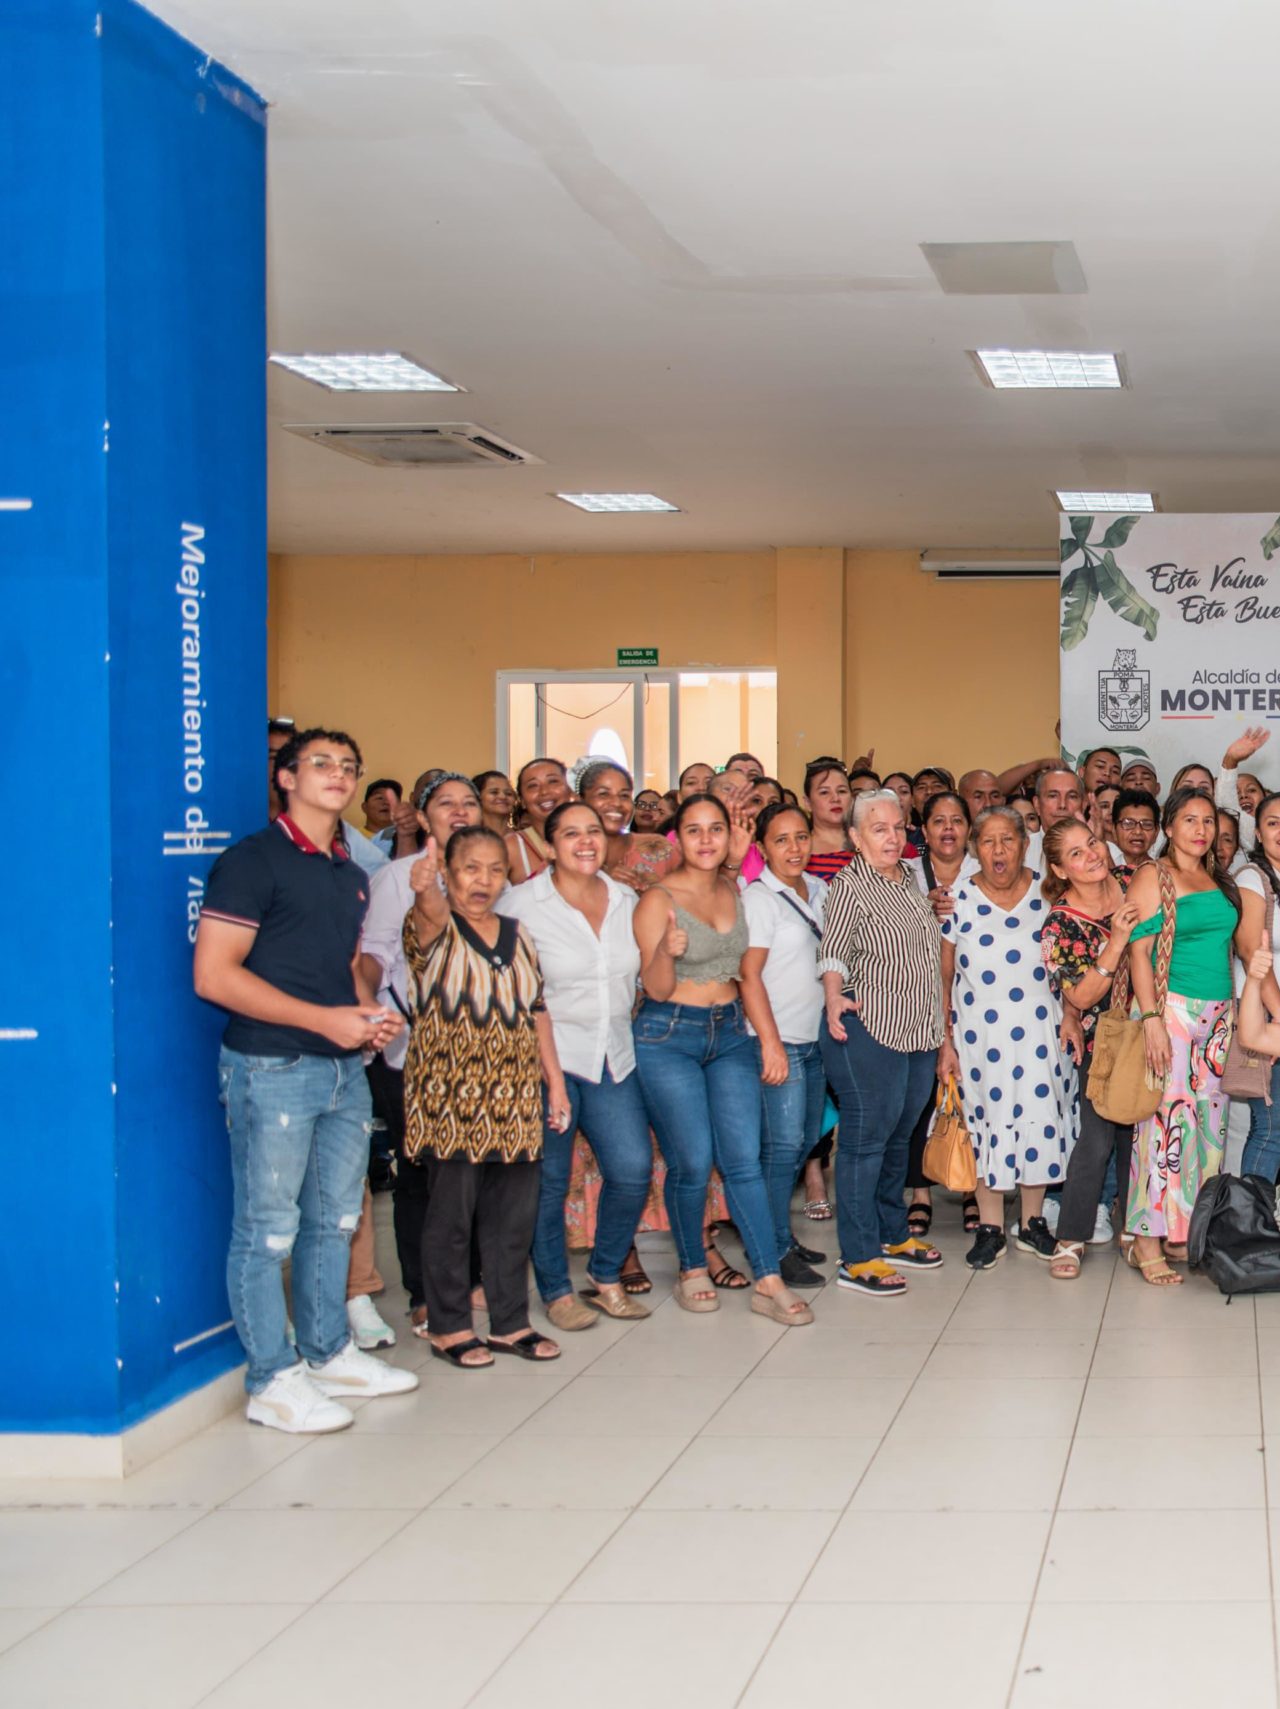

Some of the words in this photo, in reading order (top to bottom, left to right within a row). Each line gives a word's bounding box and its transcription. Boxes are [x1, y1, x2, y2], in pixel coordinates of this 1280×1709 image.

[1145, 562, 1202, 595] Esta
[1209, 556, 1268, 592] Vaina
[1177, 595, 1228, 625] Esta
[175, 522, 206, 793] Mejoramiento
[1192, 669, 1260, 684] Alcaldía
[185, 806, 209, 854] de
